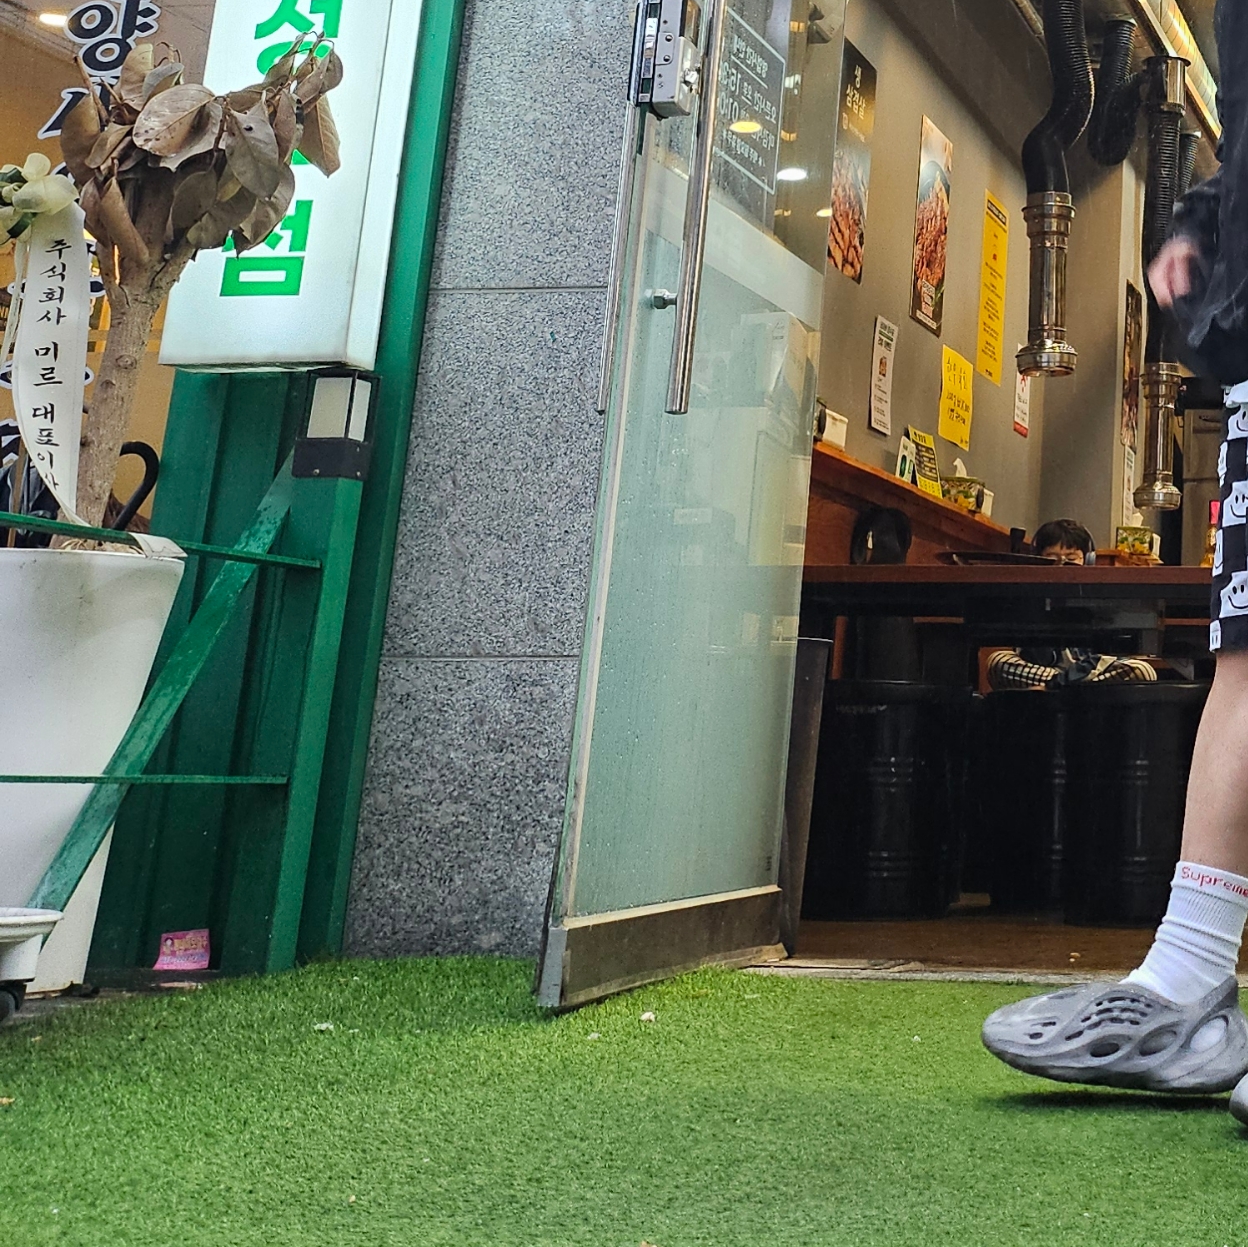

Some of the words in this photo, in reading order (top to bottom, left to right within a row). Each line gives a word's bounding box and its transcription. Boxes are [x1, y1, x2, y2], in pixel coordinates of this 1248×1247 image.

[854, 64, 862, 89] 생
[846, 84, 866, 120] 삼겹살
[36, 238, 72, 326] 주식회사
[32, 341, 64, 387] 미르
